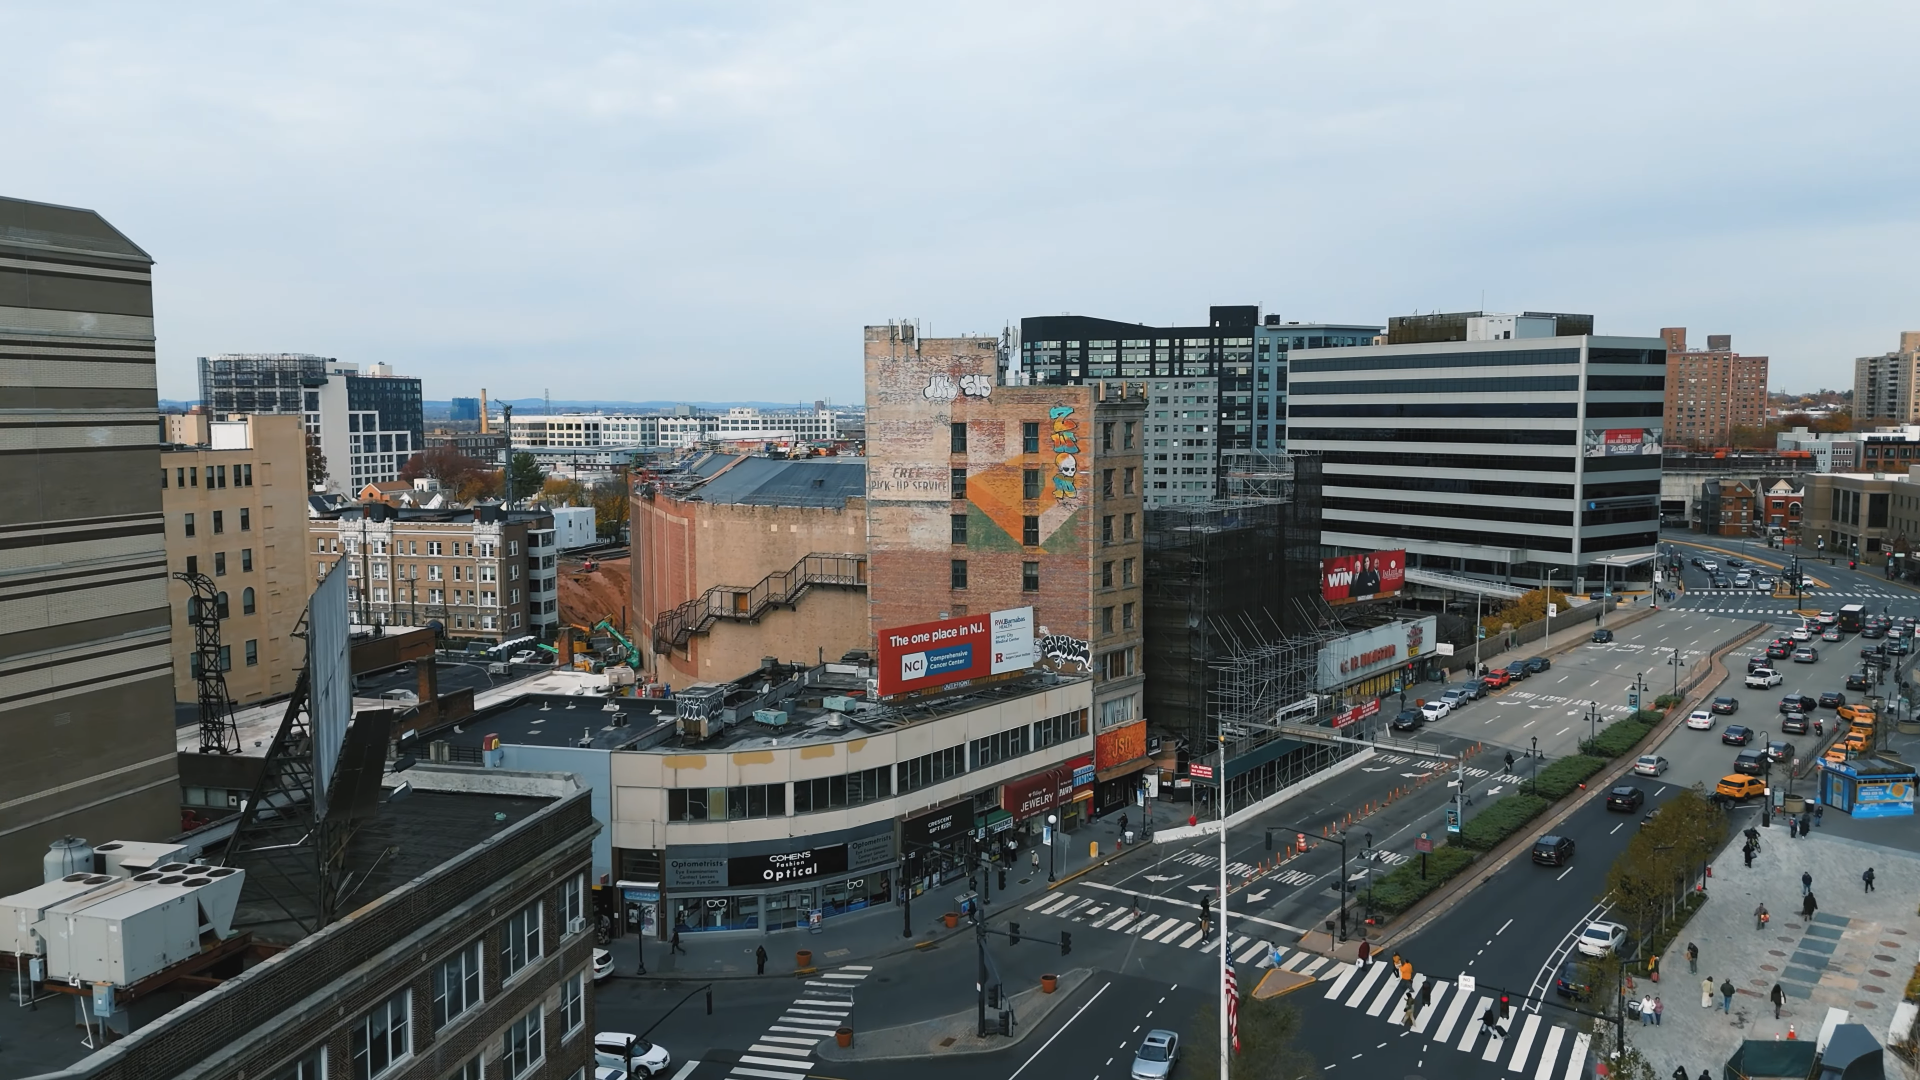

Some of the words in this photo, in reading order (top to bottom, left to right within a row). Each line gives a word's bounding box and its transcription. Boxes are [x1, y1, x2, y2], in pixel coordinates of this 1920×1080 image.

[892, 467, 924, 478] FREE
[913, 480, 948, 491] SERVICE
[1328, 571, 1352, 587] WIN
[890, 636, 909, 647] The
[911, 633, 930, 643] one
[932, 629, 958, 644] place
[959, 625, 968, 636] in
[970, 622, 985, 635] NJ.
[930, 650, 968, 662] Comprehensive
[995, 653, 1003, 663] R
[904, 660, 923, 673] NCI
[930, 660, 947, 670] Cancer
[948, 658, 964, 668] Center
[1374, 754, 1410, 765] ONLY
[1059, 785, 1072, 797] PAWN
[1020, 792, 1054, 812] JEWELRY
[928, 815, 953, 828] CRESCENT
[929, 826, 940, 834] GIFT
[852, 835, 891, 849] Optometrists
[769, 851, 811, 863] COHEN'S
[1173, 853, 1218, 868] ONLY
[671, 860, 723, 868] Optometrists
[763, 864, 818, 881] Optical
[1268, 870, 1316, 886] ONLY
